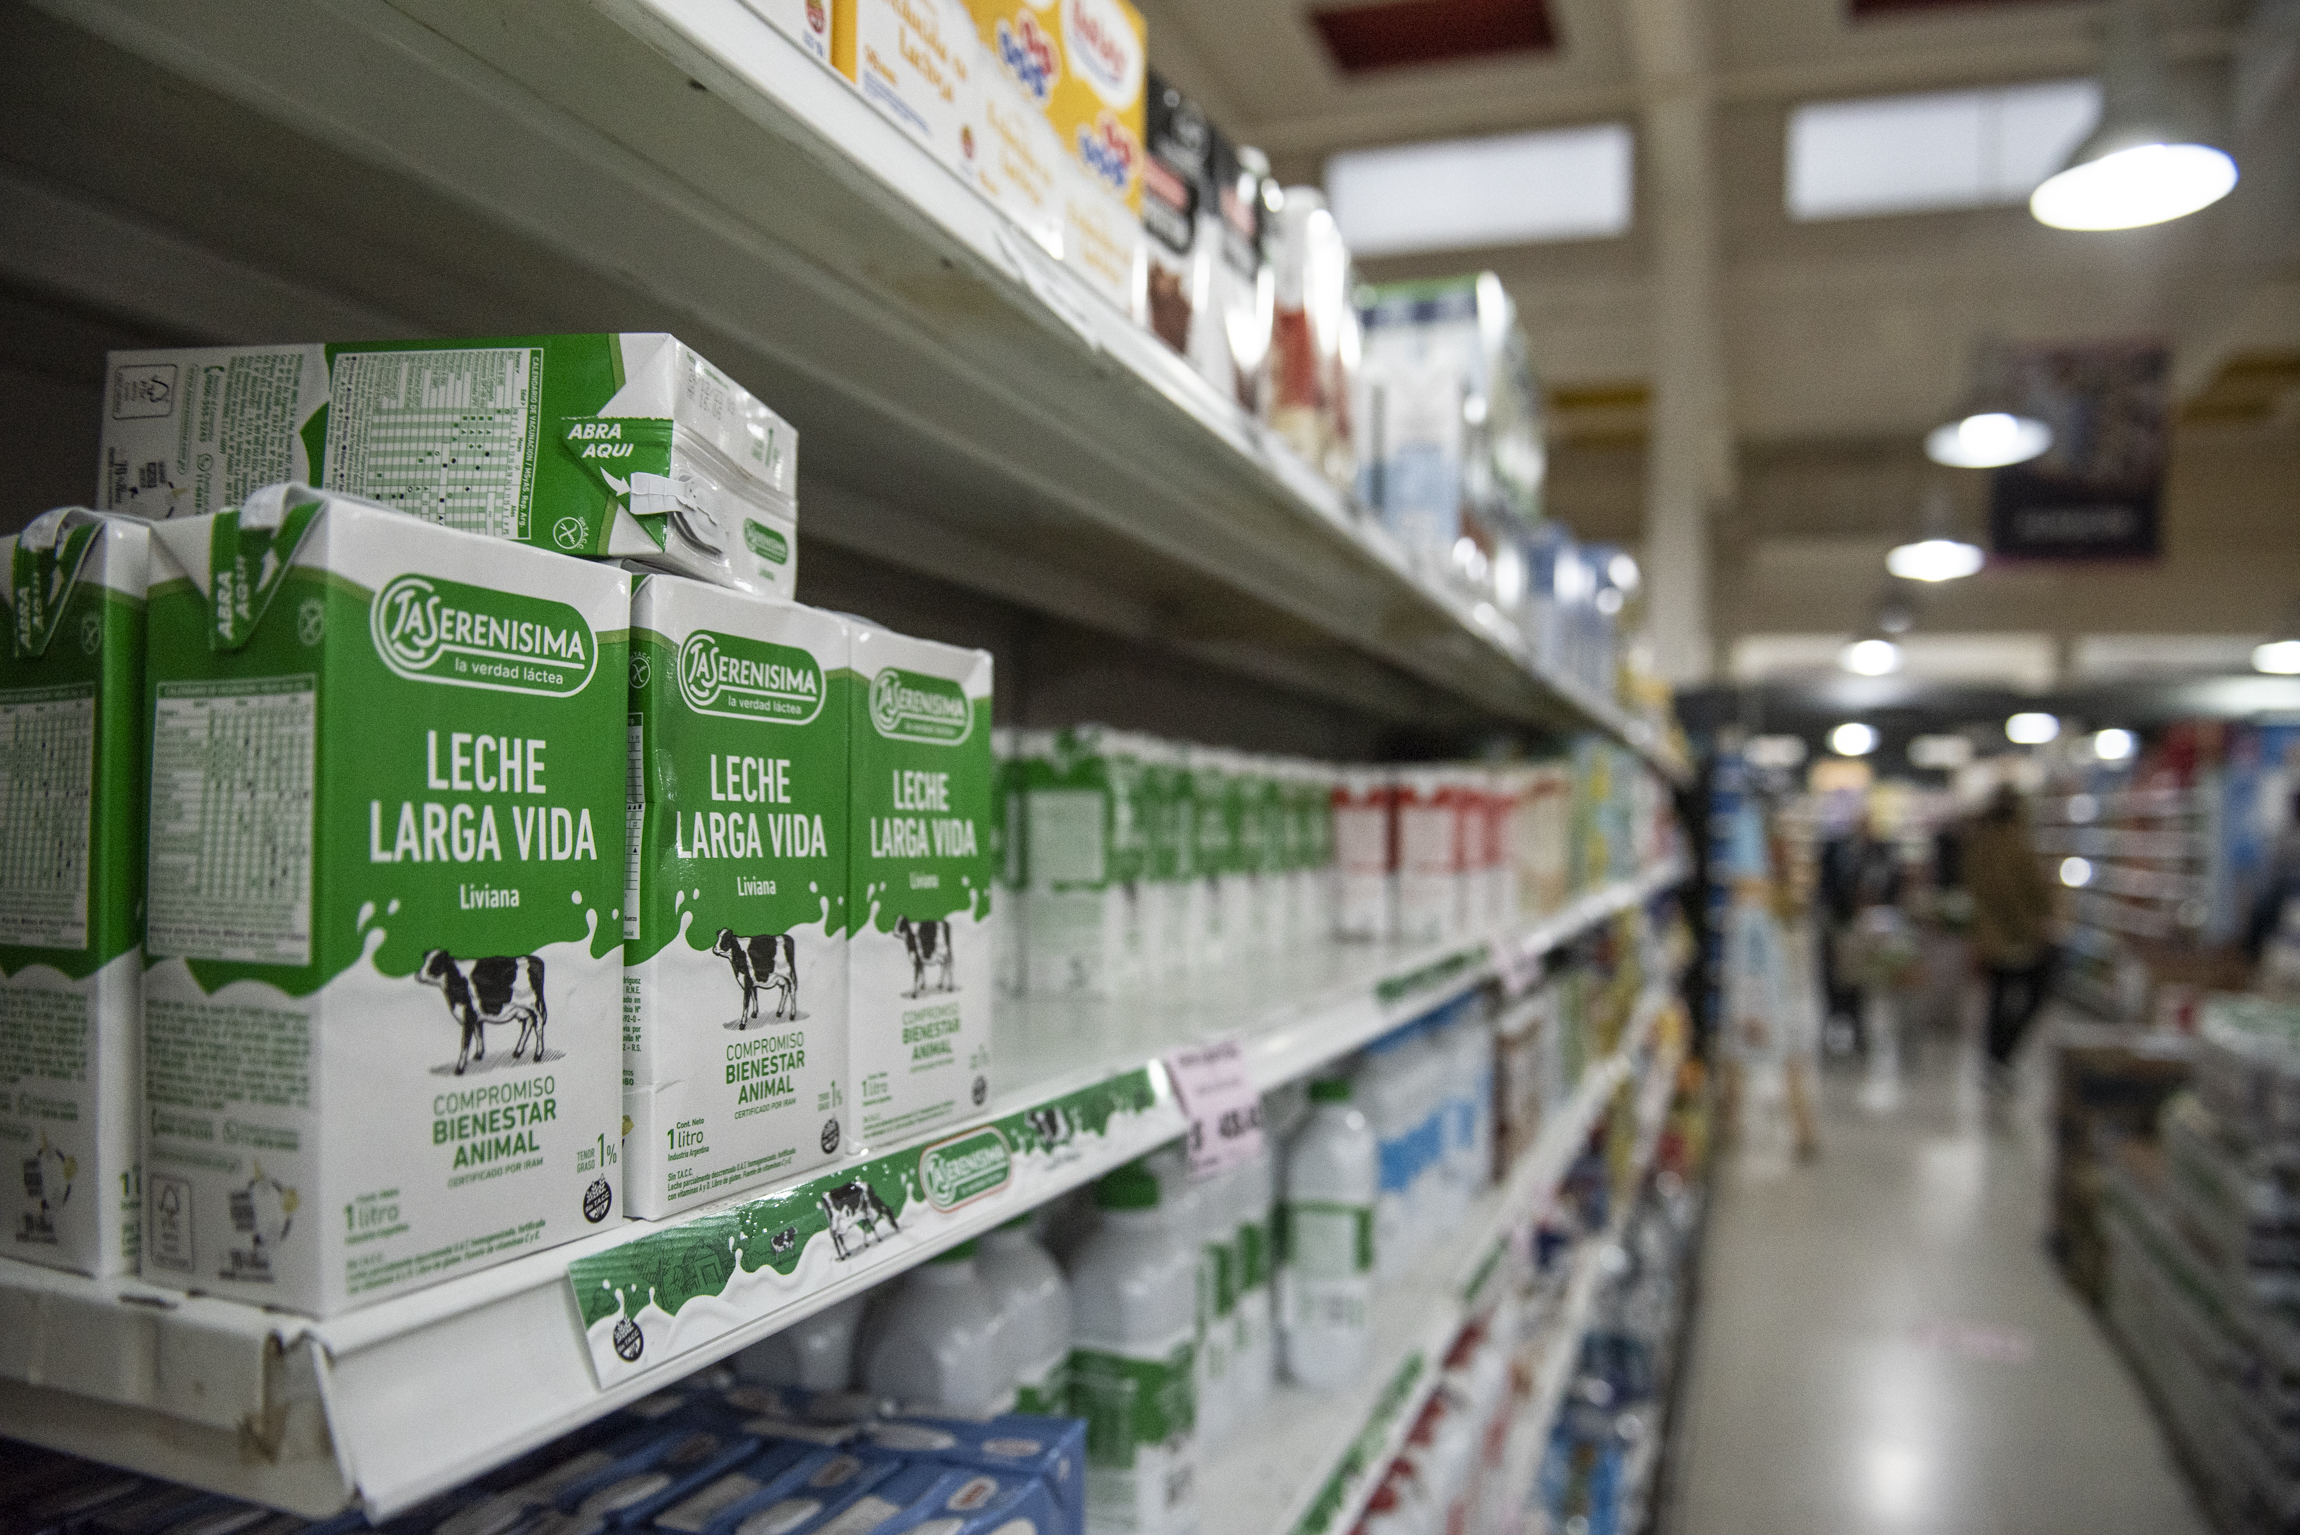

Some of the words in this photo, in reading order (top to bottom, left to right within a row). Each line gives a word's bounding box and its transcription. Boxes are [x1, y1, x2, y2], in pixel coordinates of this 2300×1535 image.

[529, 356, 540, 403] CALENDARIO
[567, 423, 621, 440] ABRA
[582, 443, 634, 459] AQUI
[455, 657, 467, 672] la
[471, 661, 519, 680] verdad
[523, 667, 564, 685] láctea
[728, 695, 737, 707] la
[739, 699, 771, 712] verdad
[427, 729, 547, 794] LECHE
[711, 754, 791, 803] LECHE
[893, 769, 950, 811] LECHE
[370, 800, 502, 863] LARGA
[512, 805, 598, 861] VIDA
[676, 811, 763, 859] LARGA
[768, 813, 828, 858] VIDA
[871, 817, 930, 858] LARGA
[932, 818, 978, 857] VIDA
[459, 883, 520, 910] Liviana
[737, 876, 777, 896] Liviana
[726, 1031, 804, 1061] COMPROMISO
[726, 1050, 805, 1084] BIENESTAR
[432, 1075, 556, 1117] COMPROMISO
[738, 1075, 794, 1105] ANIMAL
[432, 1098, 557, 1146] BIENESTAR
[452, 1130, 540, 1171] ANIMAL
[577, 1147, 595, 1162] TENOR
[667, 1128, 674, 1150] 1
[678, 1130, 703, 1148] litro
[577, 1159, 595, 1174] GRASO
